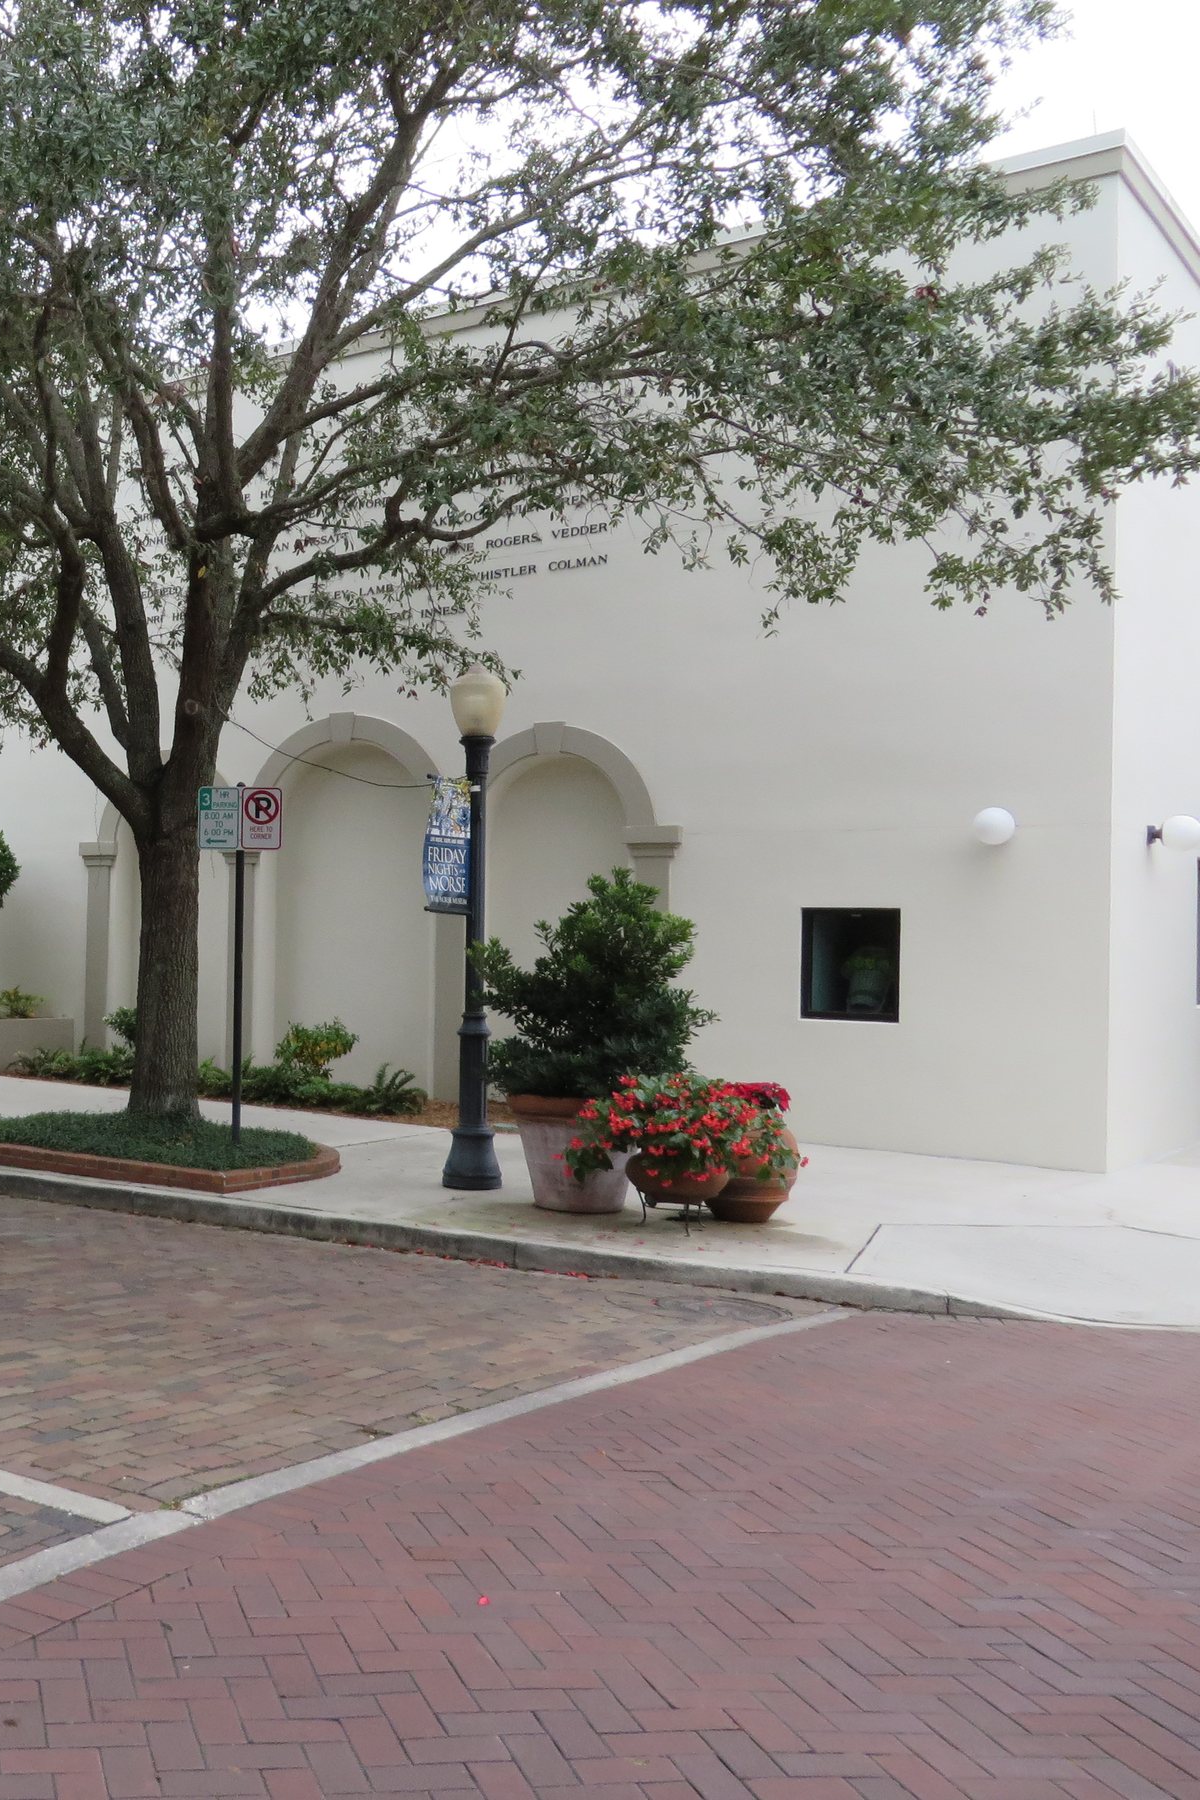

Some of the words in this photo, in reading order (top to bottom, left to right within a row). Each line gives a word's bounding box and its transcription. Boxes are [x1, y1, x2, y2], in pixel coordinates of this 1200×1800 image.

[486, 533, 541, 549] ROGERS
[551, 522, 608, 539] VEDDER
[548, 554, 608, 571] COLMAN
[201, 793, 211, 807] 3
[219, 791, 230, 799] HR
[212, 801, 238, 809] PARKING
[223, 811, 234, 820] AM
[215, 820, 224, 828] TO
[223, 828, 234, 836] PM
[428, 846, 467, 864] FRIDAY
[428, 862, 459, 876] NIGHTS
[429, 875, 466, 893] MORSE
